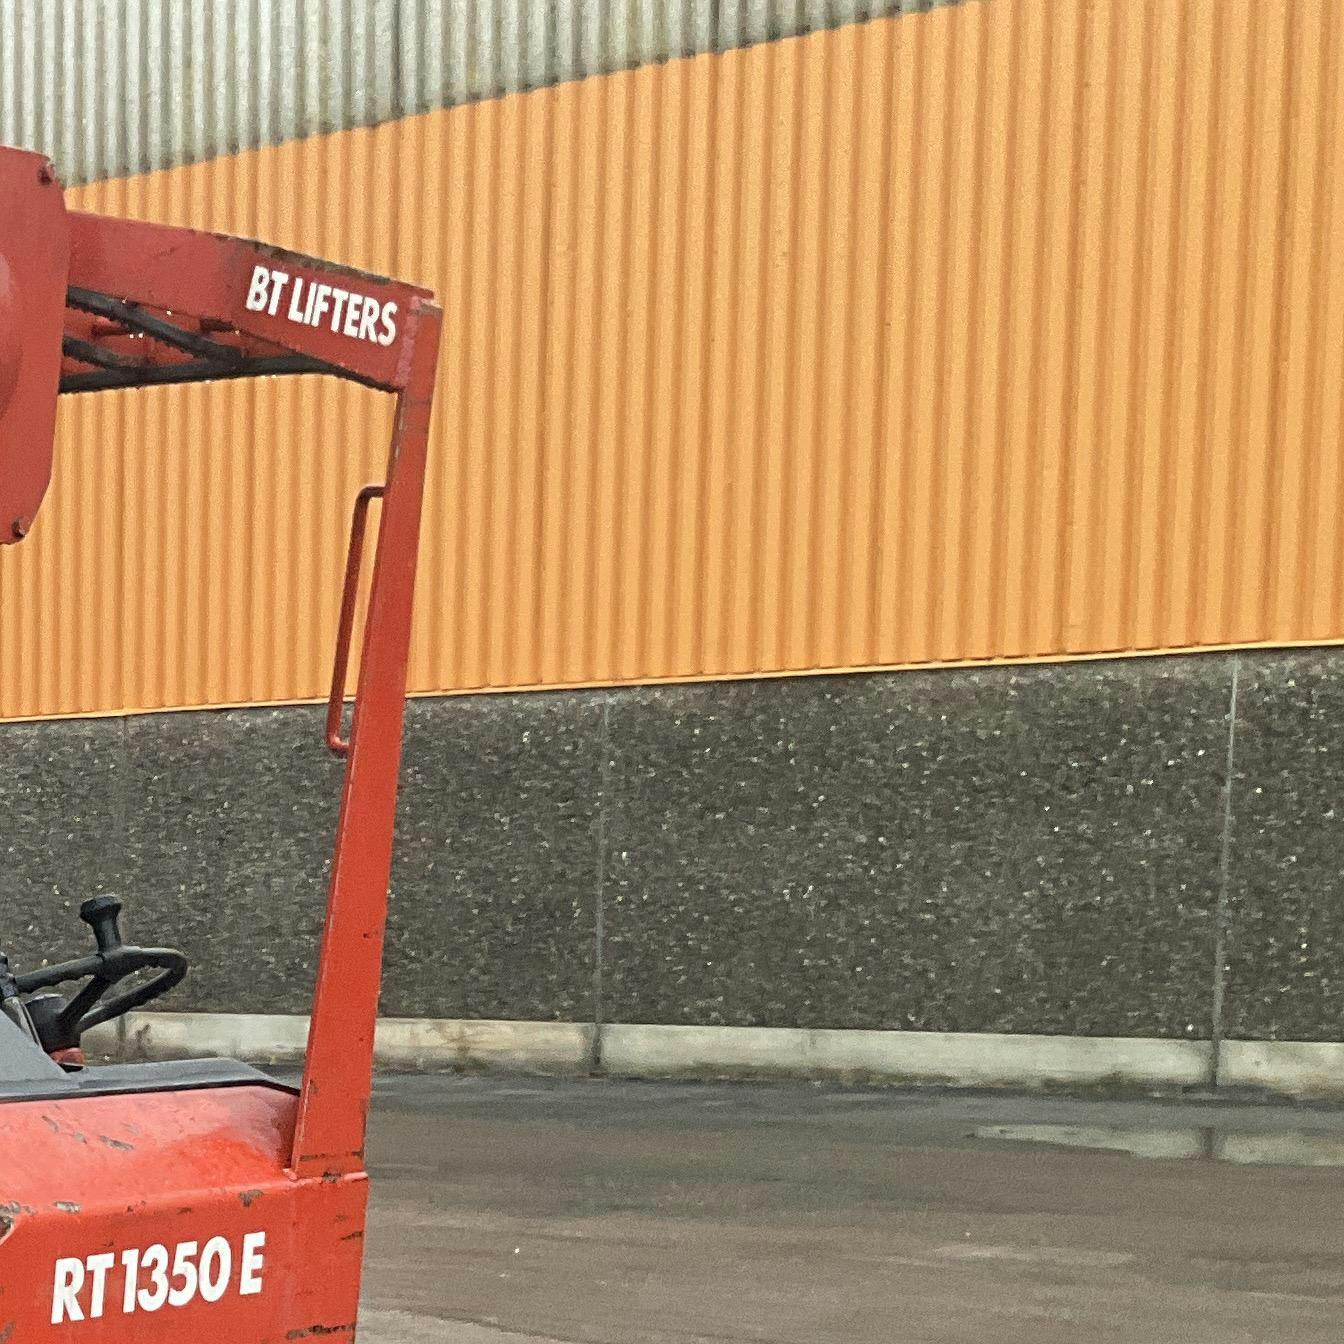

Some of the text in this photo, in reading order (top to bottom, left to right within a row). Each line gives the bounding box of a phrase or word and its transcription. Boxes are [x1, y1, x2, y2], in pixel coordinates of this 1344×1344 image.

[245, 265, 398, 347] BT LIFTERS
[51, 1231, 266, 1324] RT 1350 E
